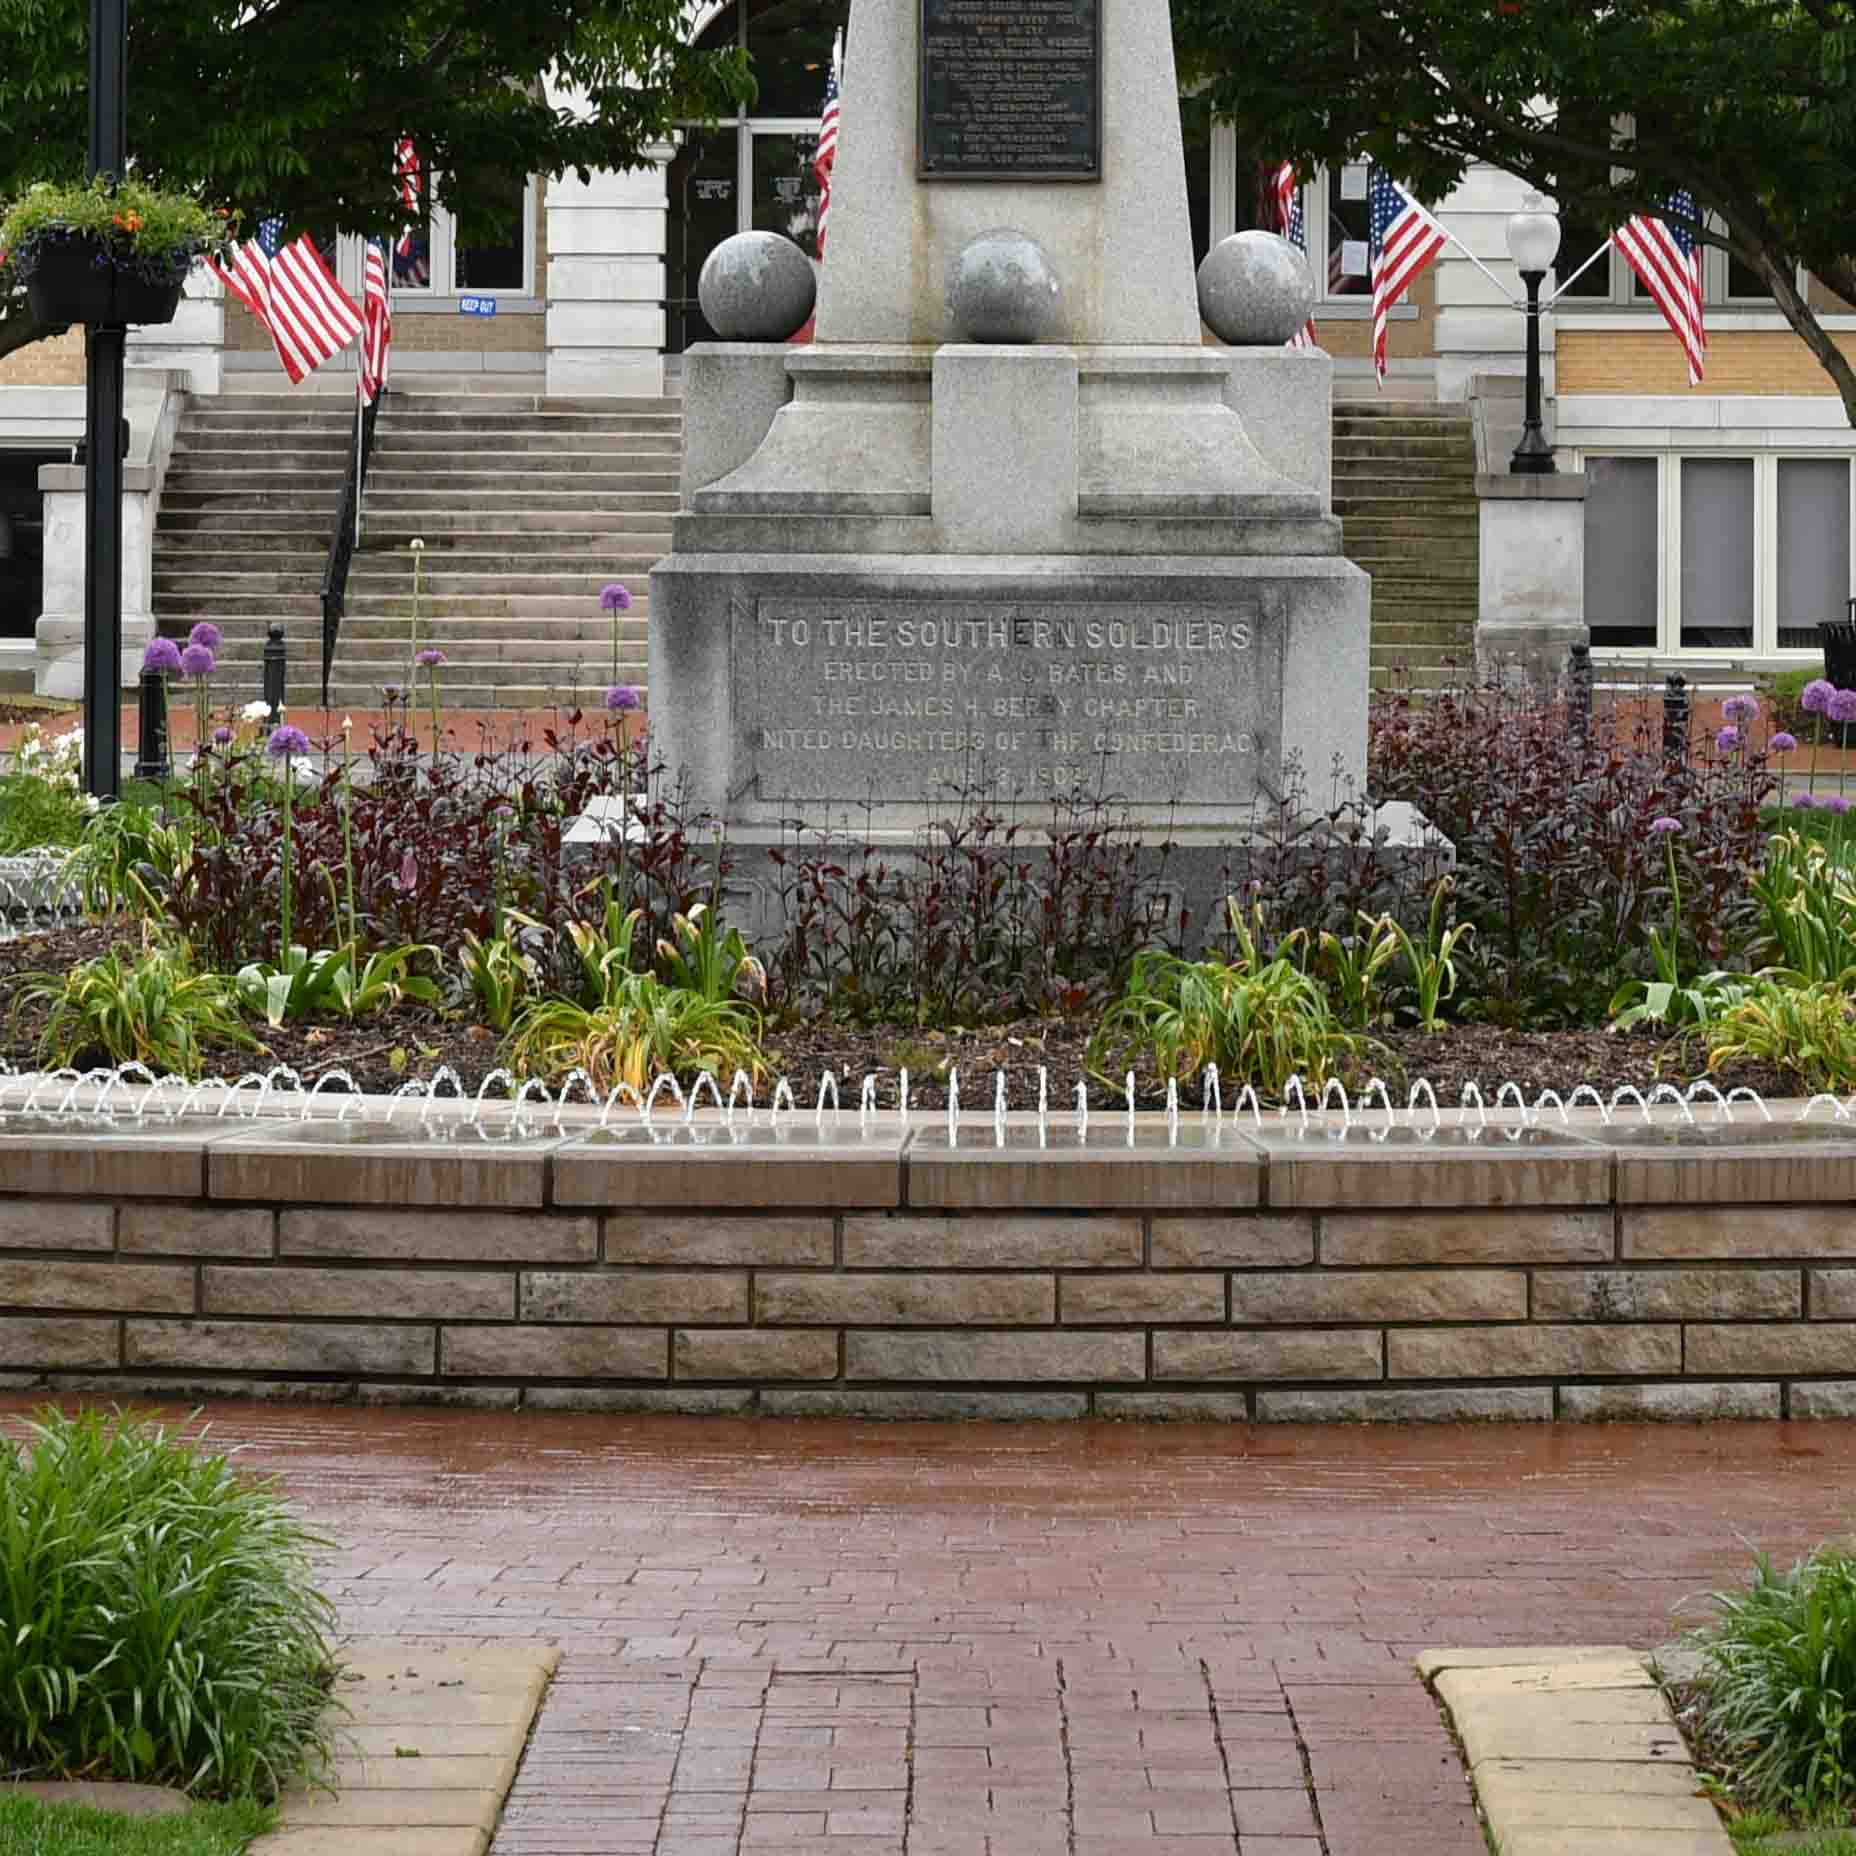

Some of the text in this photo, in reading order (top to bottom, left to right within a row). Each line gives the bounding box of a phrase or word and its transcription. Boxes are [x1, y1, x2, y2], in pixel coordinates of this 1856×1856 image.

[462, 298, 495, 313] KEEP OUT
[768, 617, 1251, 649] TO THE SOUTHERN SOLDIERS
[823, 661, 932, 681] ERECTED
[943, 662, 969, 681] BY
[1144, 663, 1193, 684] AND
[812, 696, 861, 715] THE
[871, 696, 952, 716] JAMES
[843, 730, 985, 750] DAUGHTERS
[995, 731, 1025, 751] OF
[1035, 729, 1088, 753] THE
